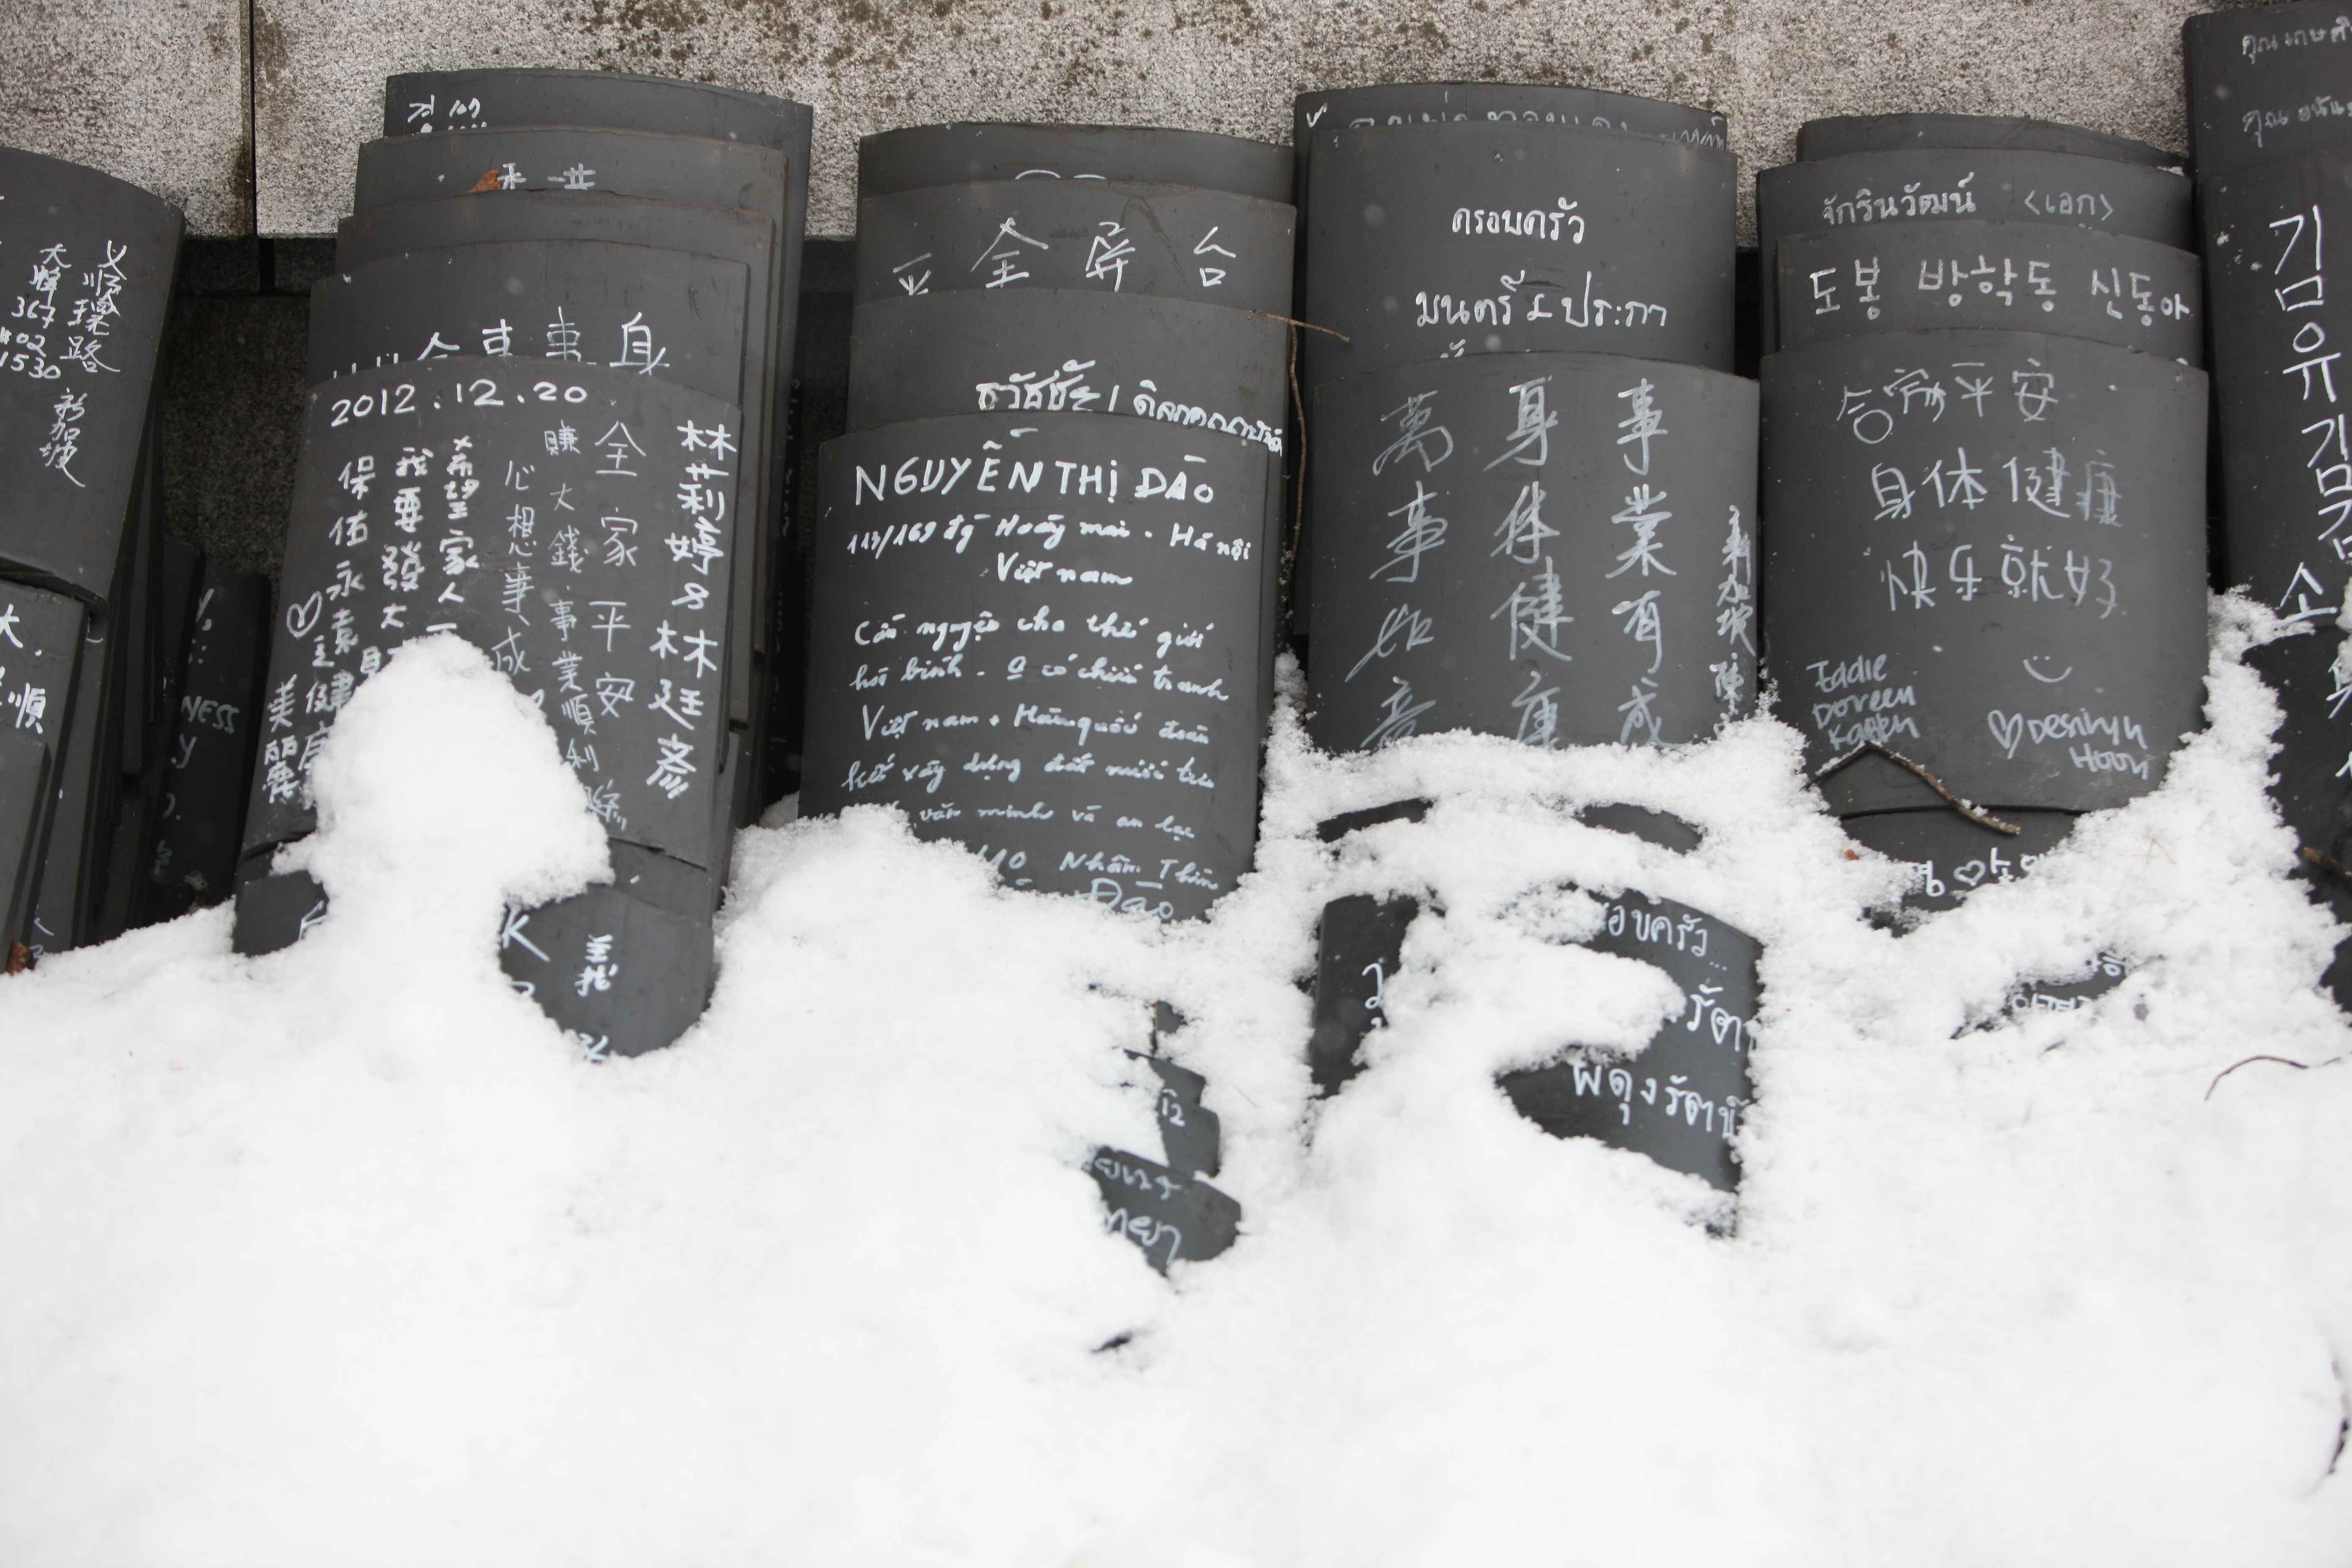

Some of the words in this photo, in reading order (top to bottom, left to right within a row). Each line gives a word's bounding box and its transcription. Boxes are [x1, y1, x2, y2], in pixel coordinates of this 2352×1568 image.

[1809, 256, 1880, 320] 도봉
[1918, 255, 2057, 312] 방학동
[2091, 267, 2190, 327] 신동아
[589, 420, 646, 718] 全家平安
